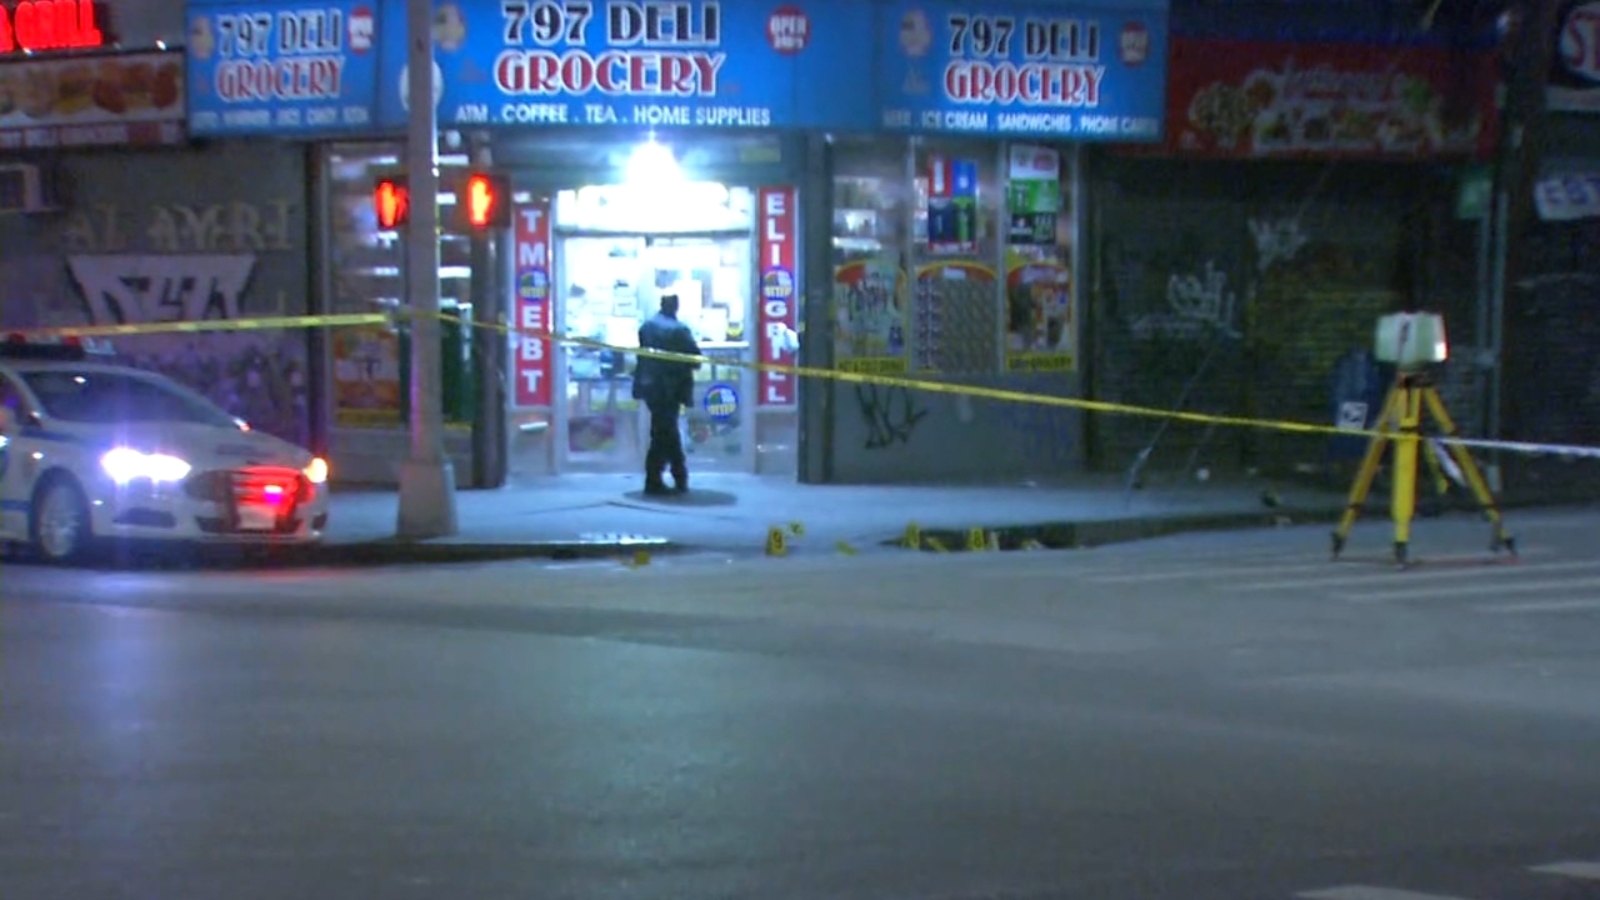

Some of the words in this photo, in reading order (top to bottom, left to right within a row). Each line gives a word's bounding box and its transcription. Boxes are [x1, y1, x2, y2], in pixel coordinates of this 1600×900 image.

[217, 13, 272, 57] 797
[278, 8, 342, 54] DELI
[502, 1, 592, 45] 797
[607, 1, 720, 47] DELI
[948, 15, 1015, 56] 797
[1024, 19, 1100, 60] DELI
[214, 56, 346, 102] GROCERY
[494, 48, 727, 96] GROCERY
[943, 60, 1105, 106] GROCERY
[455, 105, 488, 123] ATM
[502, 104, 568, 123] COFFEE
[585, 105, 617, 123] TEA
[634, 105, 690, 125] HOME
[696, 106, 771, 126] SUPPLIES
[945, 112, 988, 129] CREAM
[997, 113, 1071, 131] SANDWICHES
[520, 305, 543, 393] EBT
